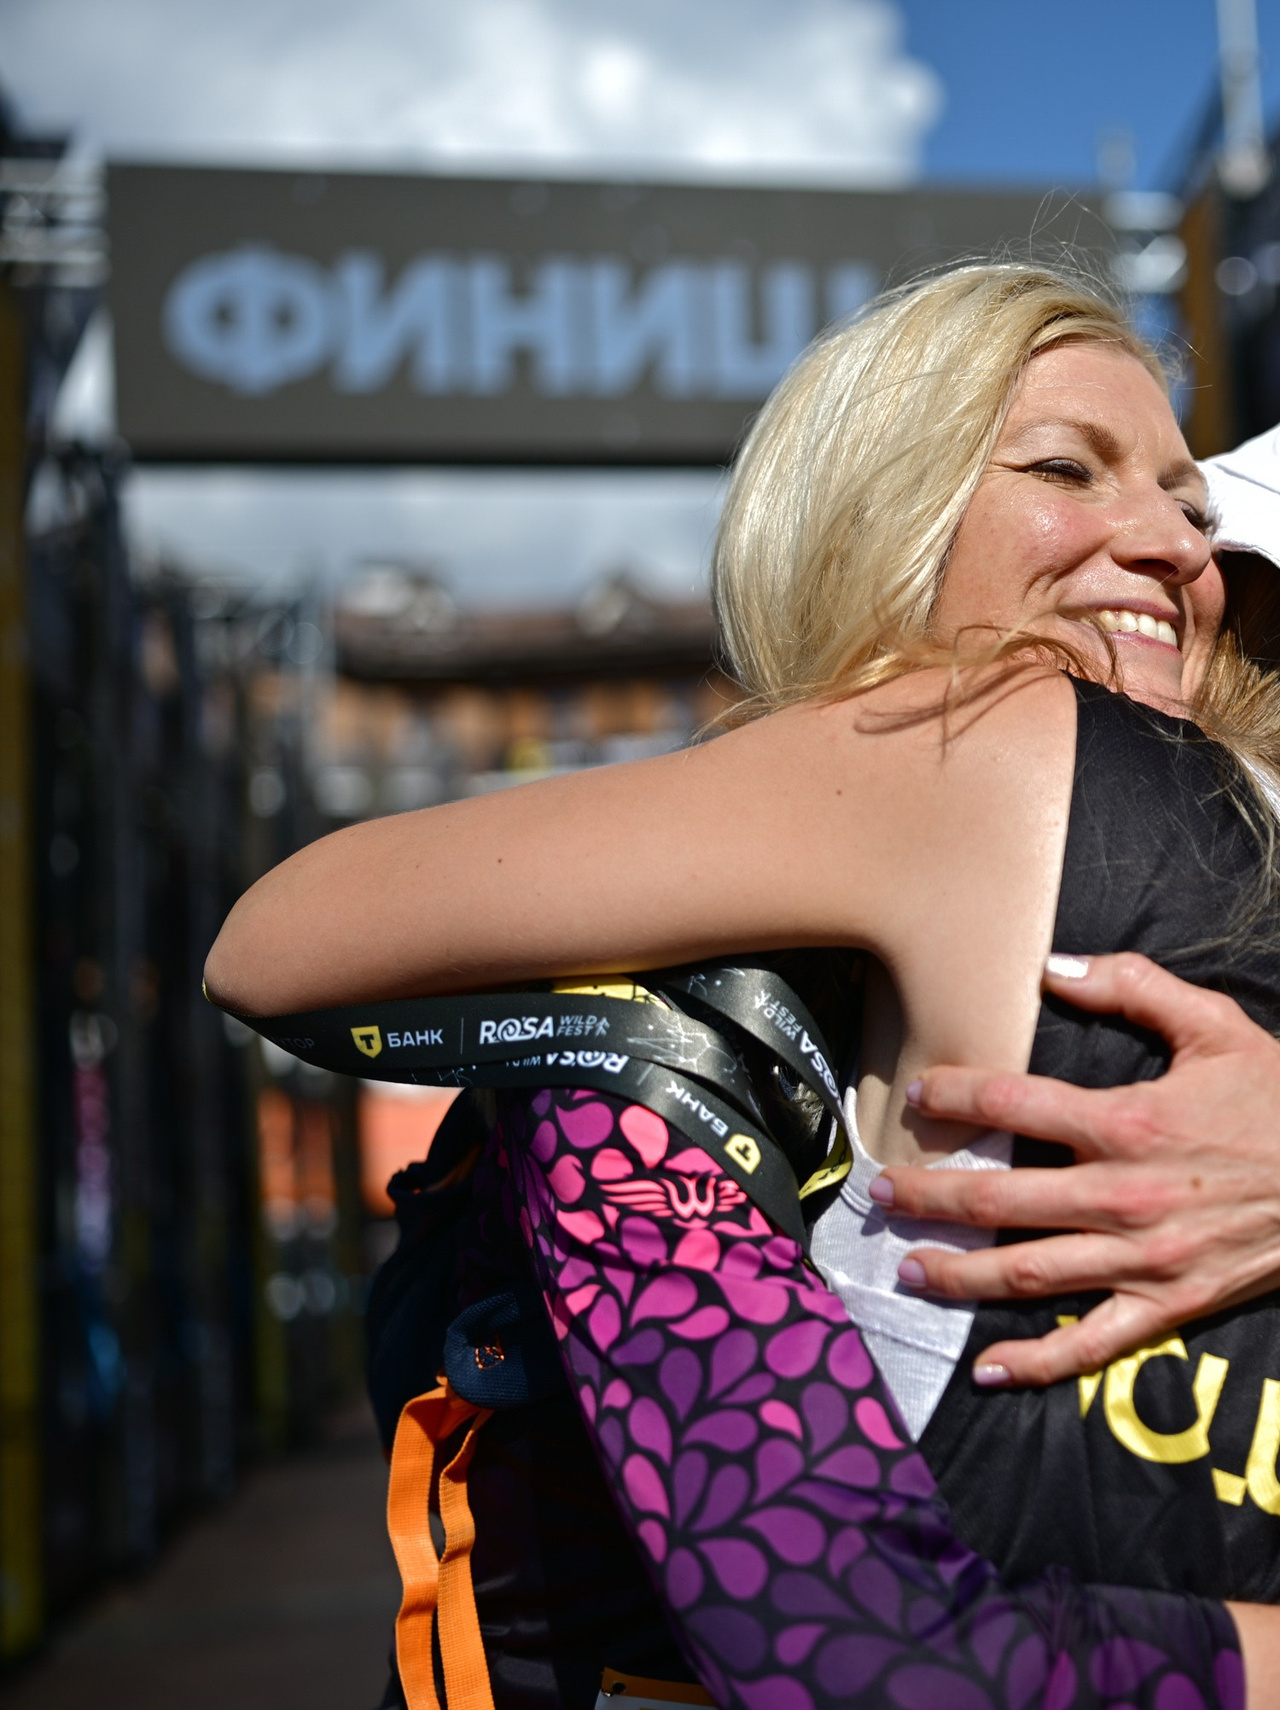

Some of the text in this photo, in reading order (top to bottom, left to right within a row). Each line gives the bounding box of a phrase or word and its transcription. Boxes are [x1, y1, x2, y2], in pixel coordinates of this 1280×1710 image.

[164, 244, 874, 393] ФИНИШ
[479, 1016, 554, 1044] ROSA
[556, 1025, 593, 1037] FEST
[560, 1015, 597, 1026] WILD
[763, 1007, 797, 1041] WILD
[772, 1001, 803, 1032] FEST
[387, 1029, 444, 1048] БАНК
[665, 1080, 729, 1135] БАНК
